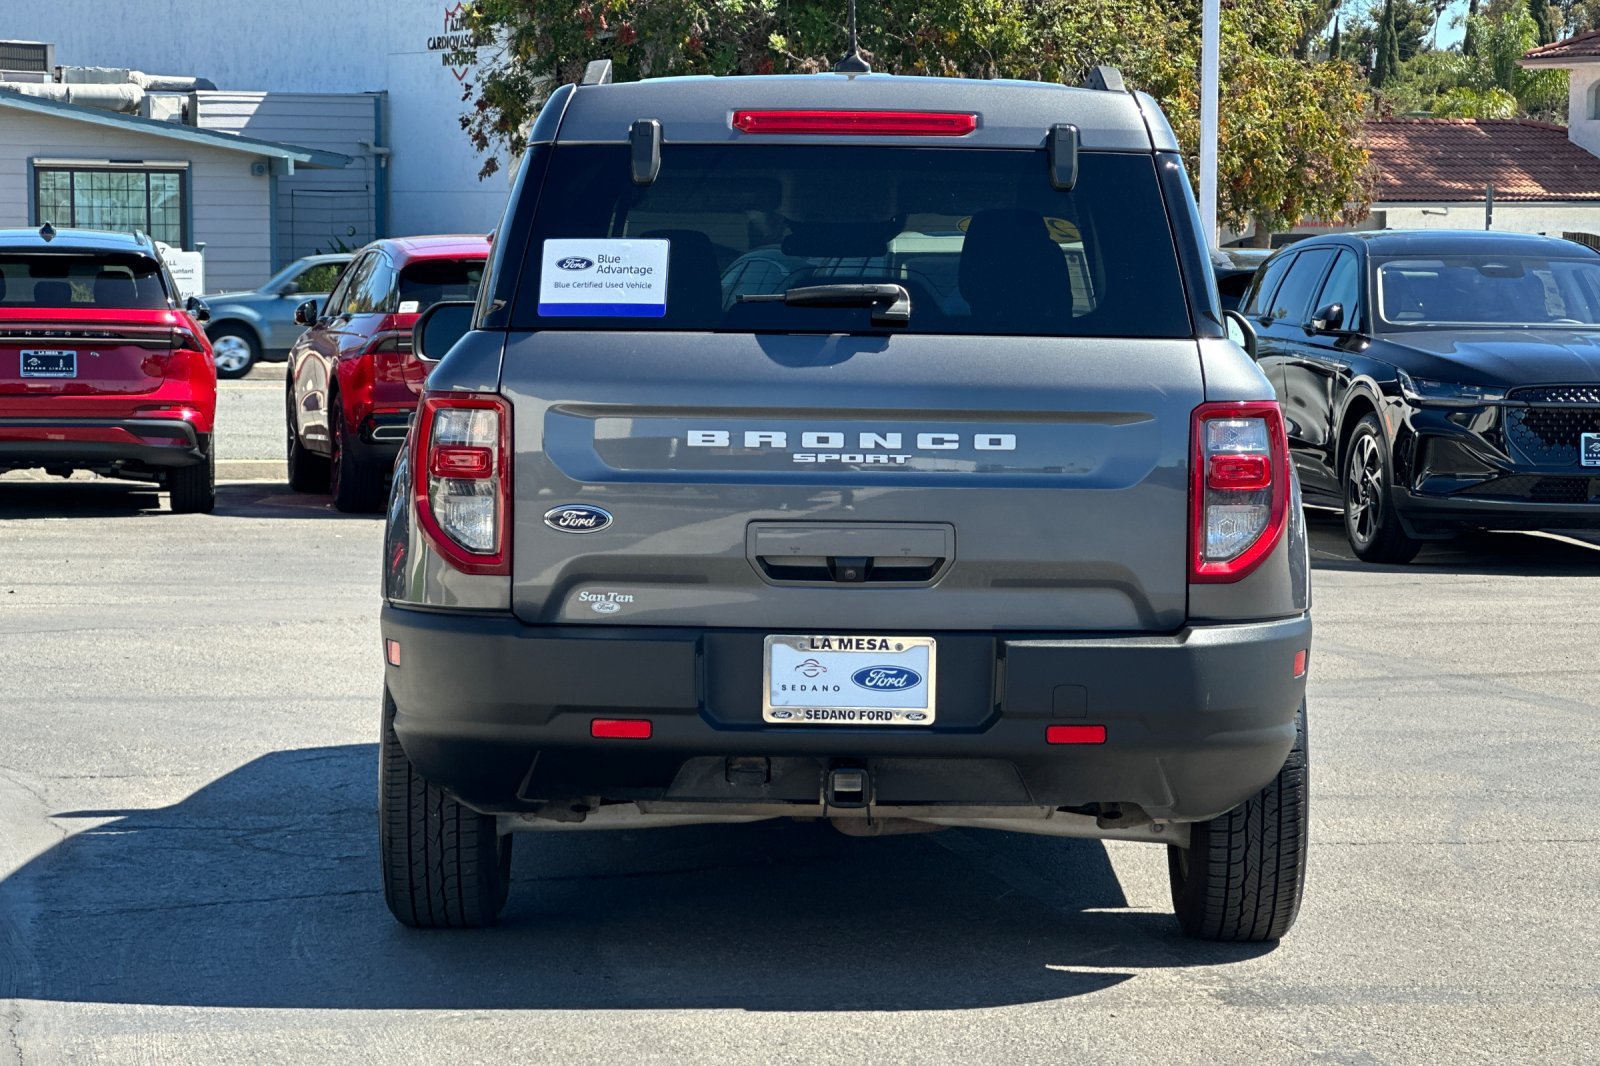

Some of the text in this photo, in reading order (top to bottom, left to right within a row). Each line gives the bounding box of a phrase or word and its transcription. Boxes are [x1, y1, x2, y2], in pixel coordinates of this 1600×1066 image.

[597, 254, 621, 264] Blue
[596, 264, 653, 276] Advantage
[554, 281, 570, 289] Blue
[572, 281, 603, 289] Certified
[605, 281, 624, 289] Used
[687, 430, 1017, 450] BRONCO
[792, 453, 912, 464] SPORT
[578, 591, 634, 603] San Tan
[810, 638, 890, 650] LA MESA
[781, 684, 841, 692] SEDANO
[805, 709, 893, 721] SEDANO FORD
